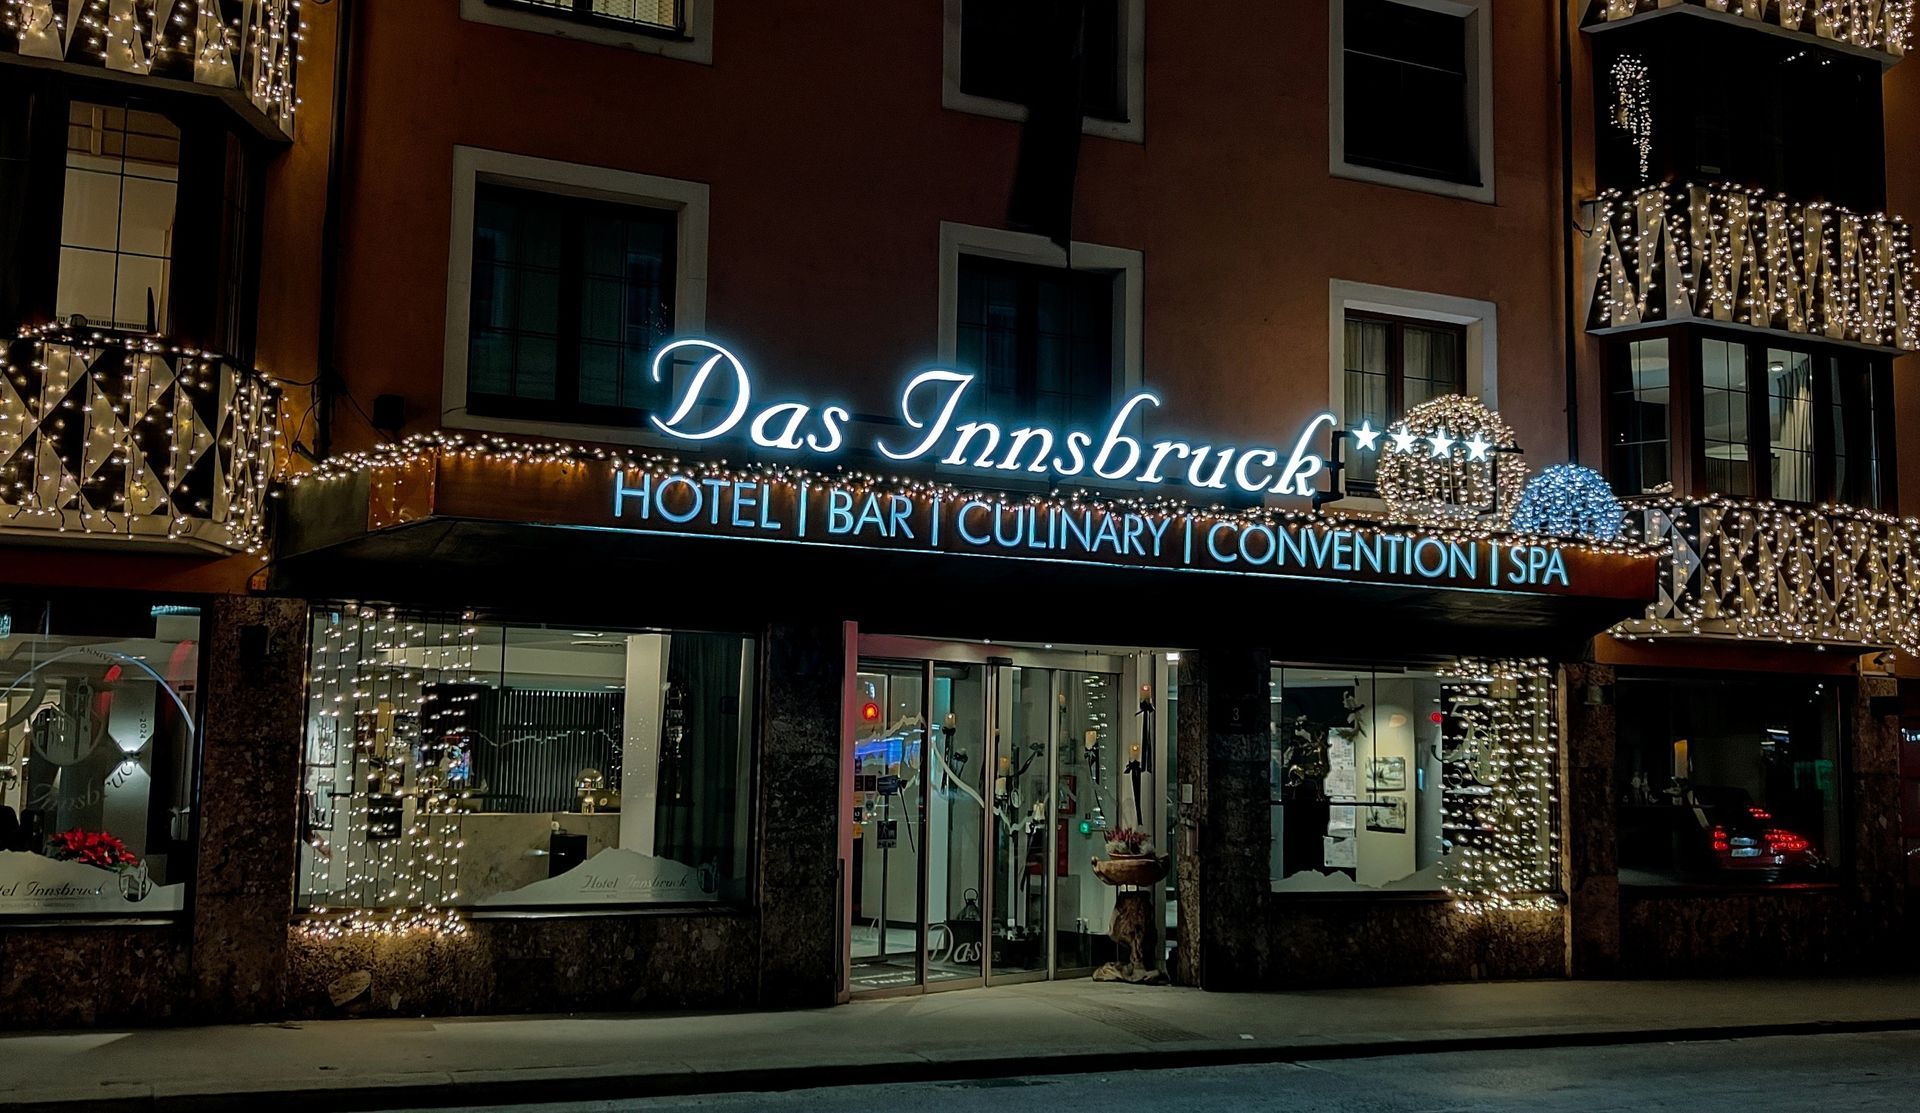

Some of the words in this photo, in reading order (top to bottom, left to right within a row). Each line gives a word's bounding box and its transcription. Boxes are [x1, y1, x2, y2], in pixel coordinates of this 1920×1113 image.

[650, 339, 850, 453] Das
[876, 369, 1338, 497] Innsbruck
[614, 470, 781, 529] HOTEL
[828, 489, 915, 538] BAR
[957, 500, 1172, 557] CULINARY
[1206, 521, 1477, 580] CONVENTION
[1507, 544, 1570, 586] SPA
[581, 874, 619, 889] Hotel
[928, 923, 982, 963] Das
